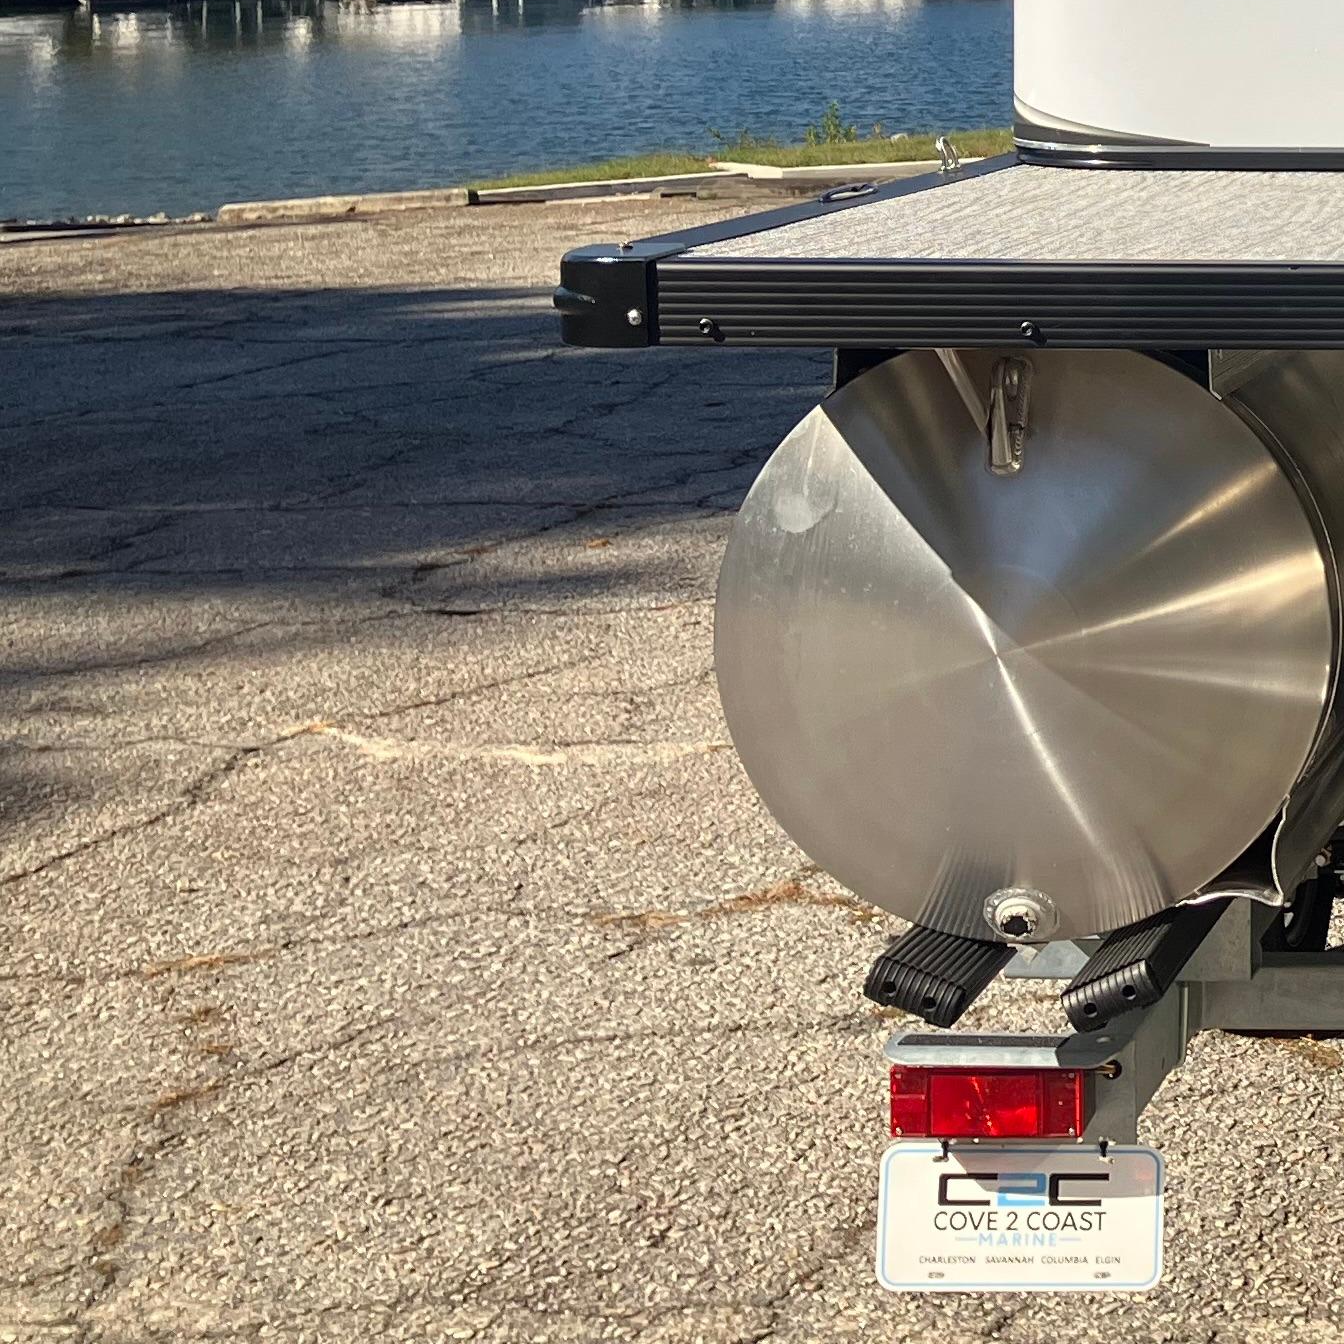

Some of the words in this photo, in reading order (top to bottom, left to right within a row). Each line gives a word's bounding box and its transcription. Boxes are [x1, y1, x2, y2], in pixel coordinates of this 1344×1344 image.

[934, 1211, 998, 1231] COVE
[1006, 1211, 1018, 1231] 2
[1026, 1211, 1107, 1231] COAST
[978, 1233, 1057, 1247] MARINE
[919, 1256, 976, 1264] CHARLESTON
[985, 1256, 1034, 1264] SAVANNAH
[1041, 1256, 1089, 1264] COLUMBIA
[1095, 1256, 1121, 1264] ELGIN
